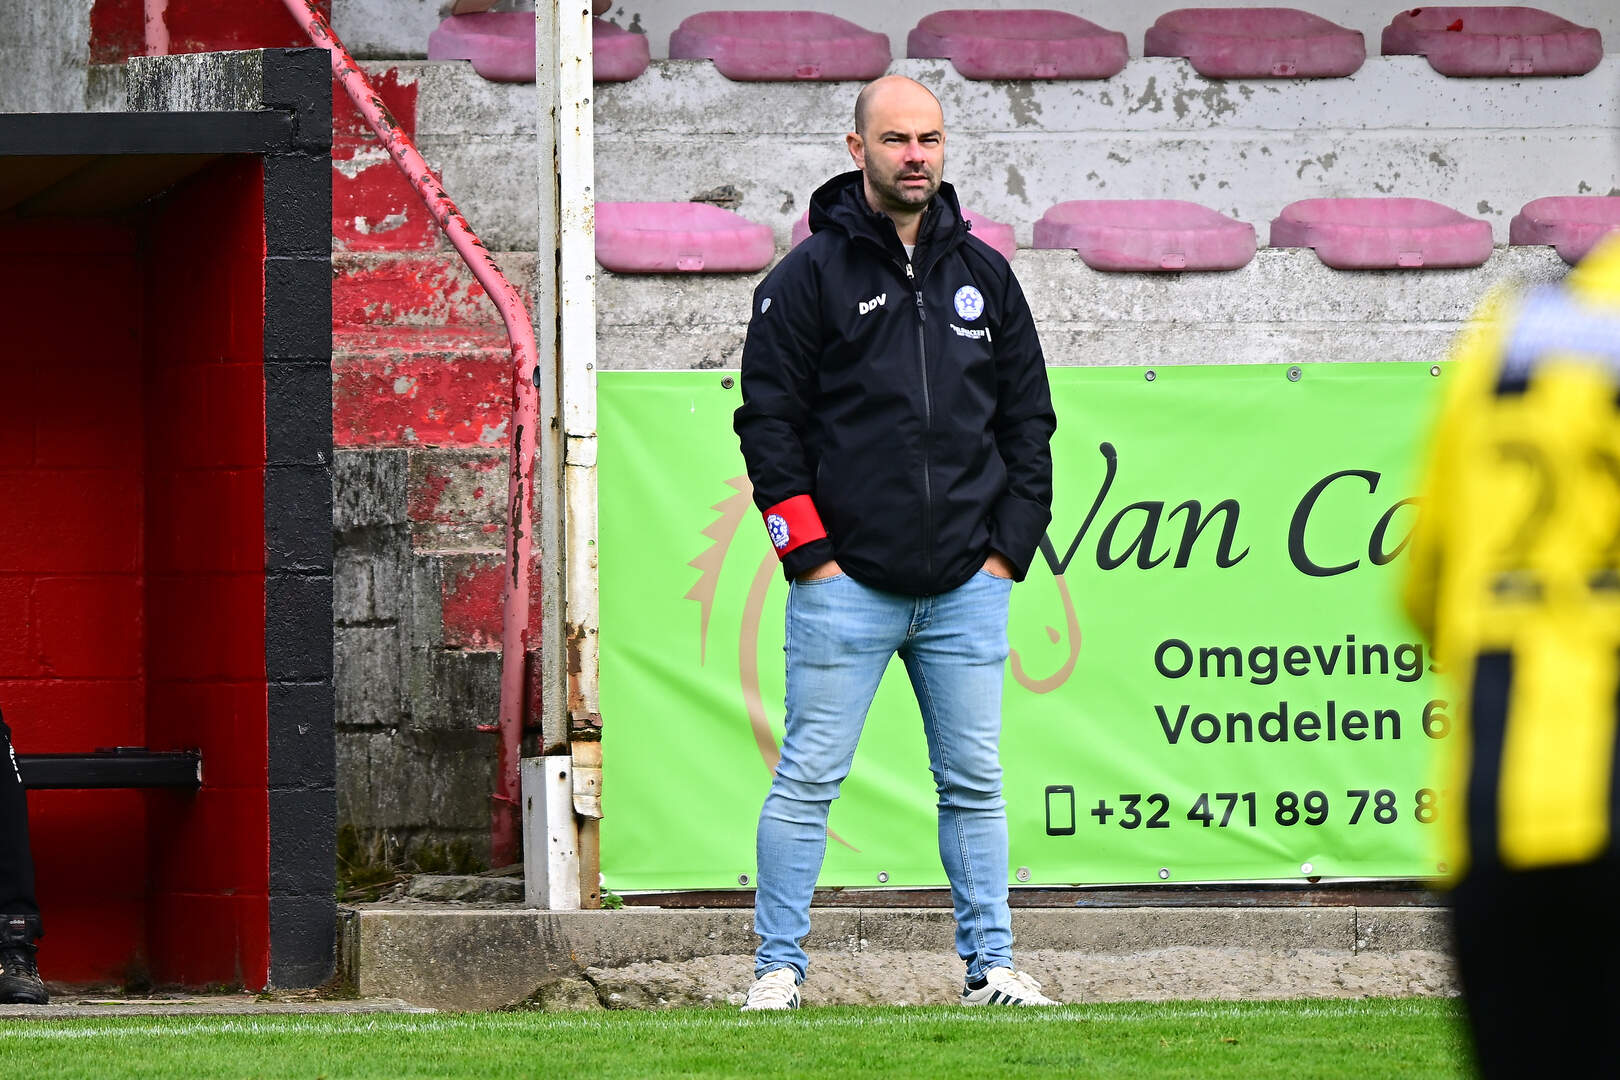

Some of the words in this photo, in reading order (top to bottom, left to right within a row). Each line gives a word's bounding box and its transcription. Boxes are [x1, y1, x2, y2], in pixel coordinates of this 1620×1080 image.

[858, 293, 887, 315] DDV
[1038, 441, 1250, 576] Van
[1154, 700, 1401, 744] Vondelen
[1421, 700, 1460, 740] 6
[1091, 793, 1171, 830] +32
[1187, 791, 1257, 828] 471
[1274, 790, 1330, 827] 89
[1346, 789, 1399, 825] 78
[1414, 788, 1444, 824] 8
